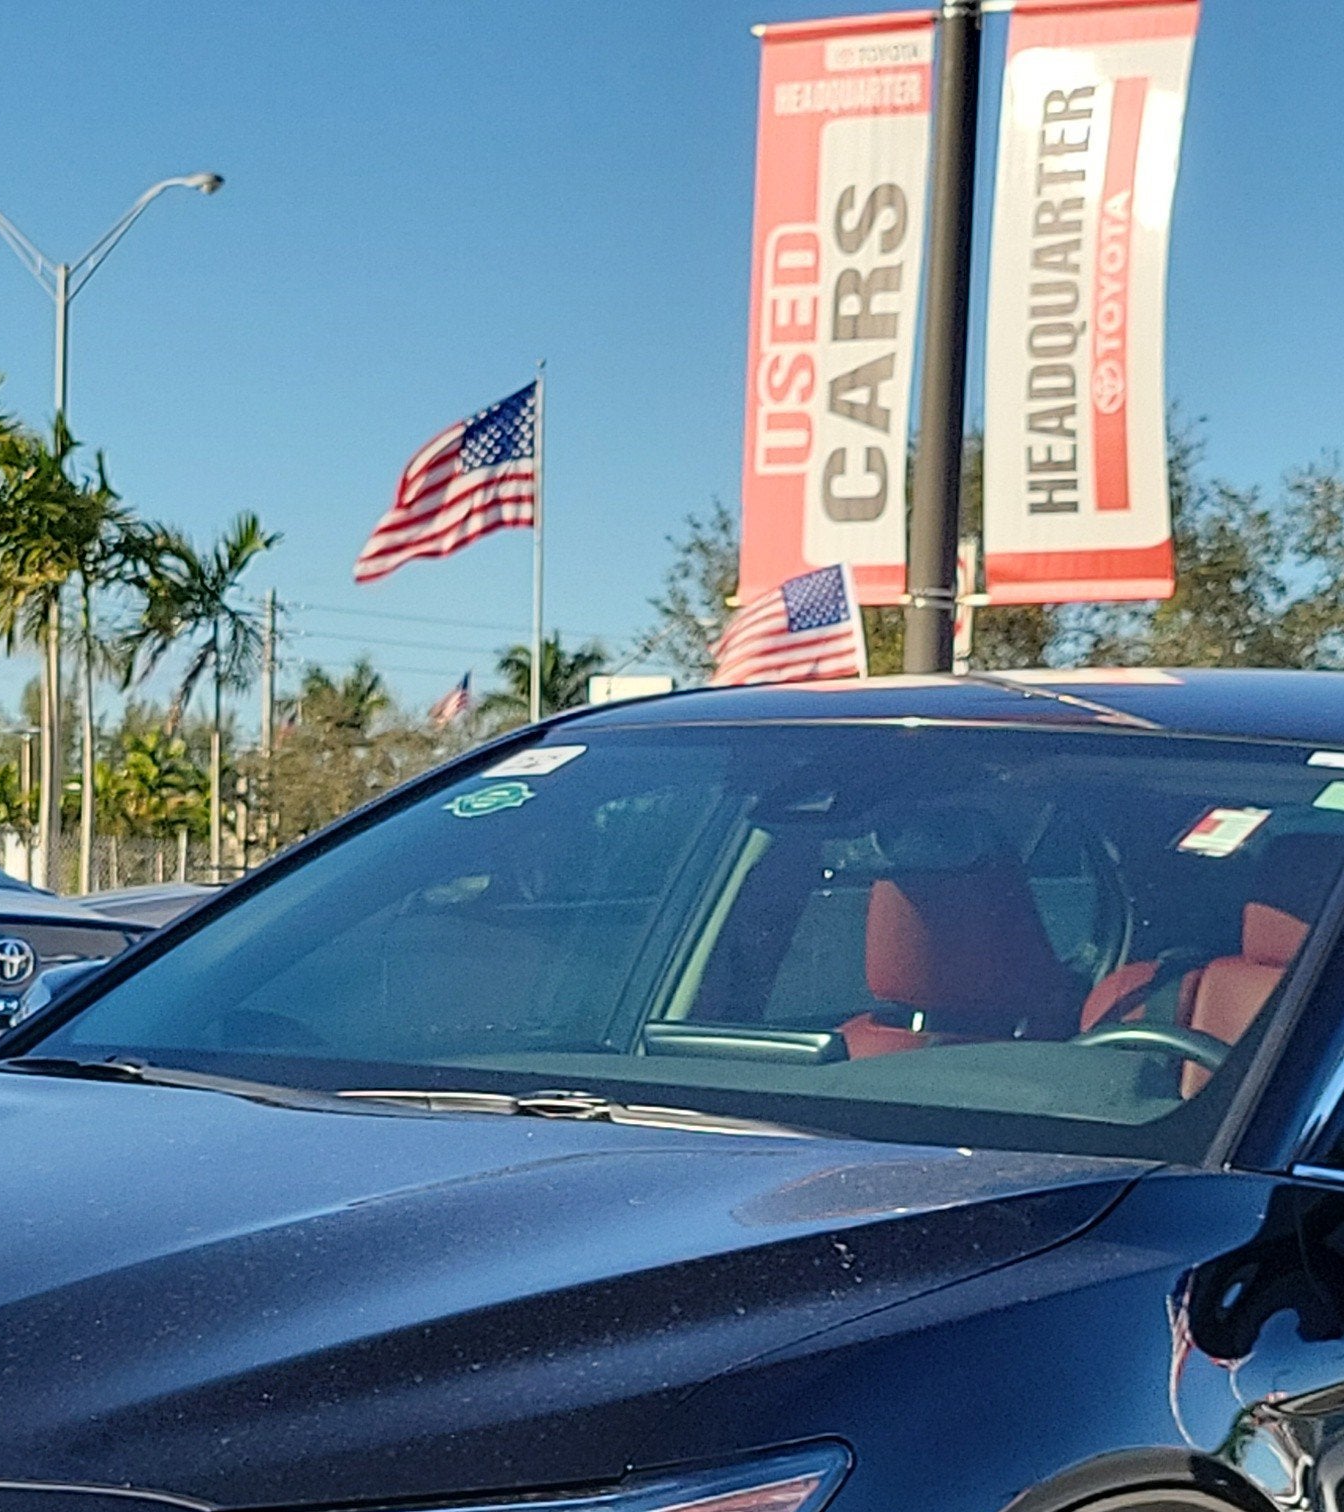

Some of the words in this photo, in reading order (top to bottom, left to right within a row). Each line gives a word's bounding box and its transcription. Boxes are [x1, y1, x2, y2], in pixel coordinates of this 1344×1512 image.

[763, 230, 817, 470] USED
[822, 182, 908, 523] CARS
[1027, 85, 1096, 517] HEADQUARTER
[1094, 190, 1131, 354] TOYOTA
